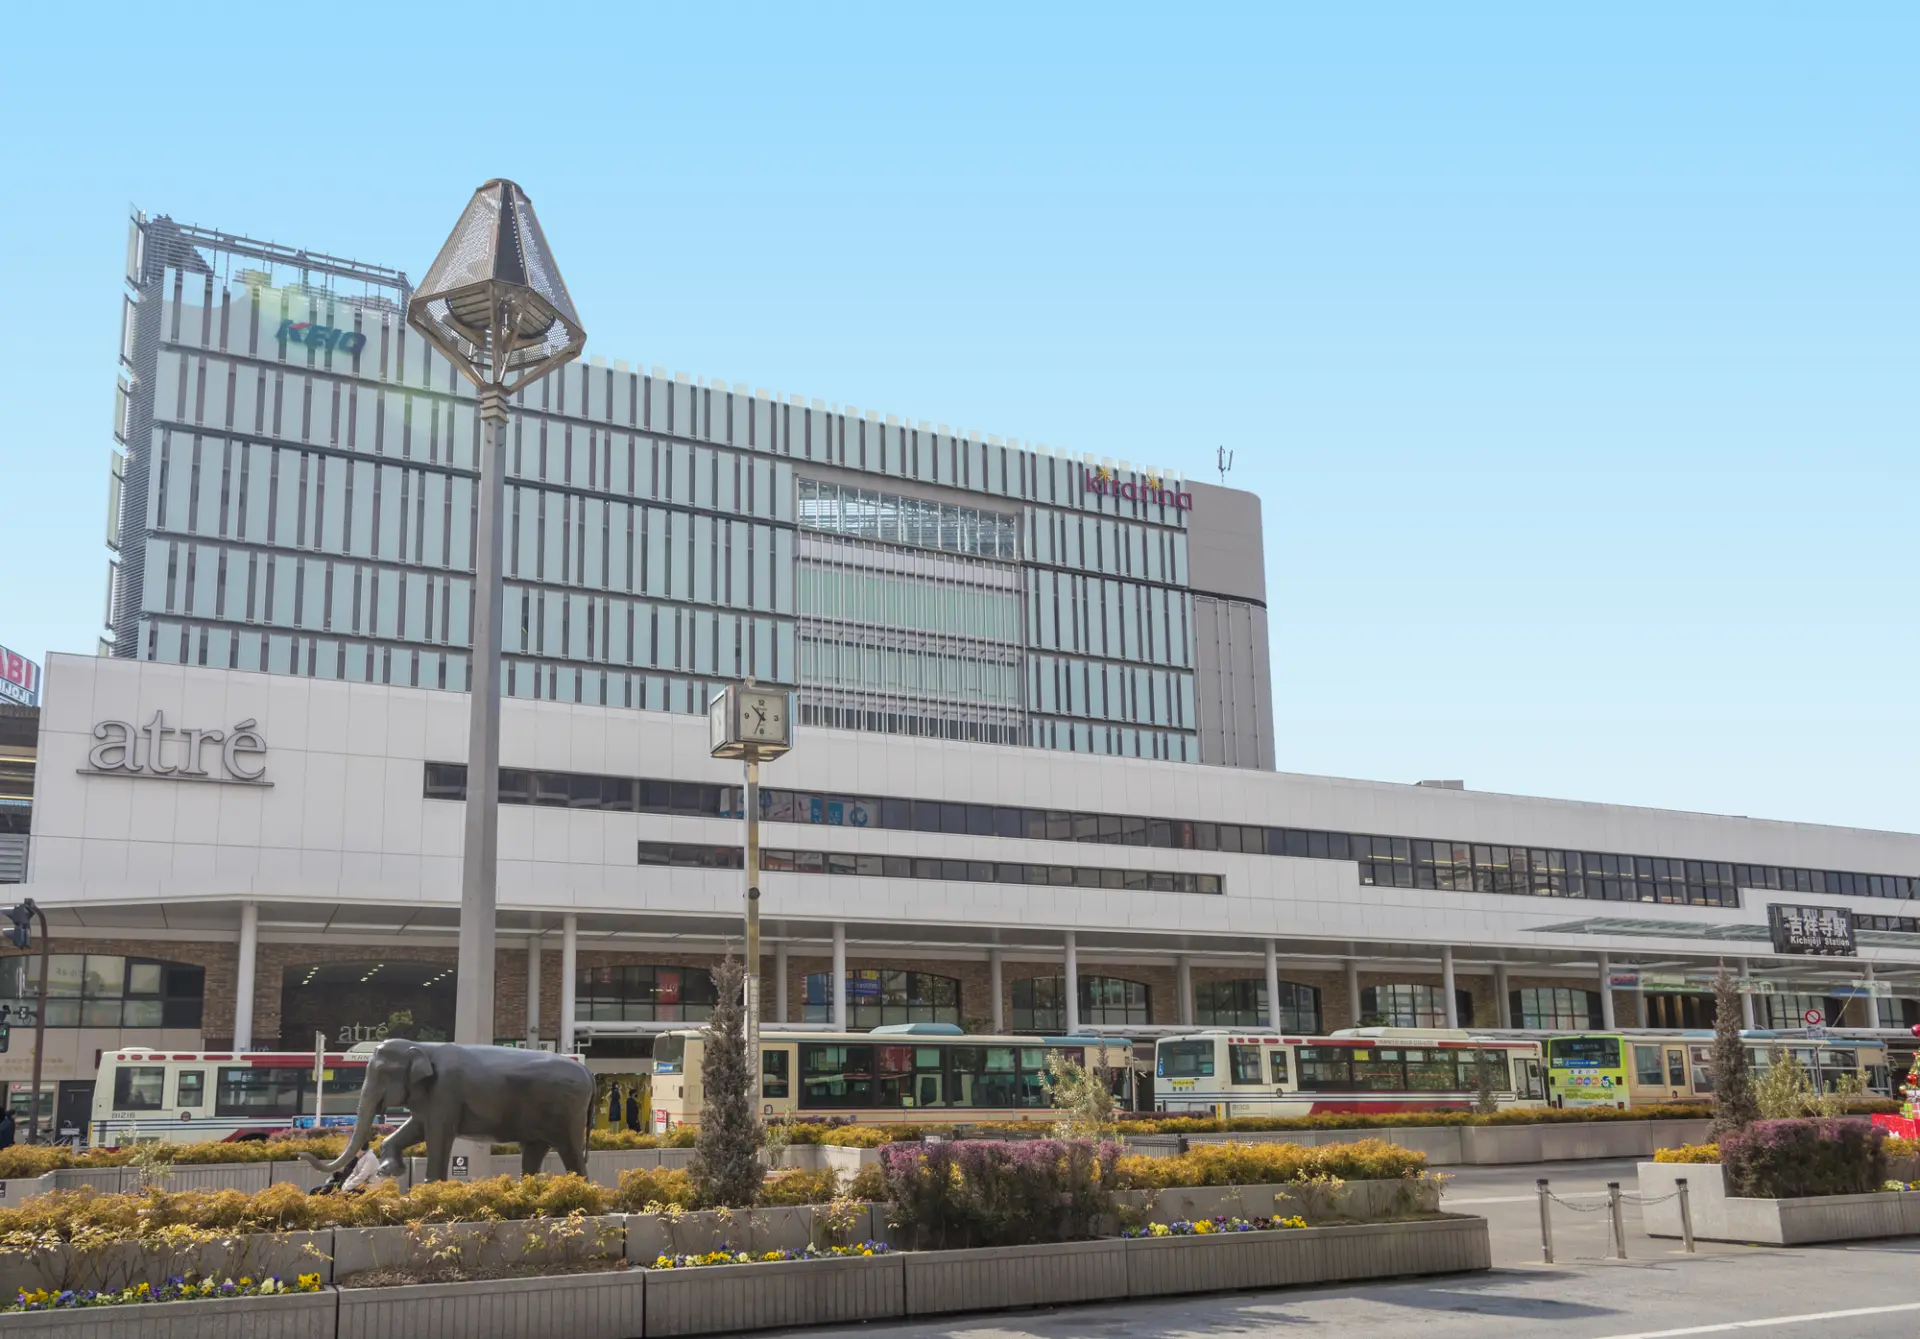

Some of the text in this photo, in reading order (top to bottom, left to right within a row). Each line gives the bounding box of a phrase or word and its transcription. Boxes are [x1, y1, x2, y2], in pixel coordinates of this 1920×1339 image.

[275, 319, 367, 356] KEIO
[1085, 464, 1193, 511] kirarina
[89, 710, 267, 780] atré
[1788, 914, 1848, 938] 吉祥寺駅
[1824, 937, 1850, 947] Station
[339, 1021, 388, 1041] atré
